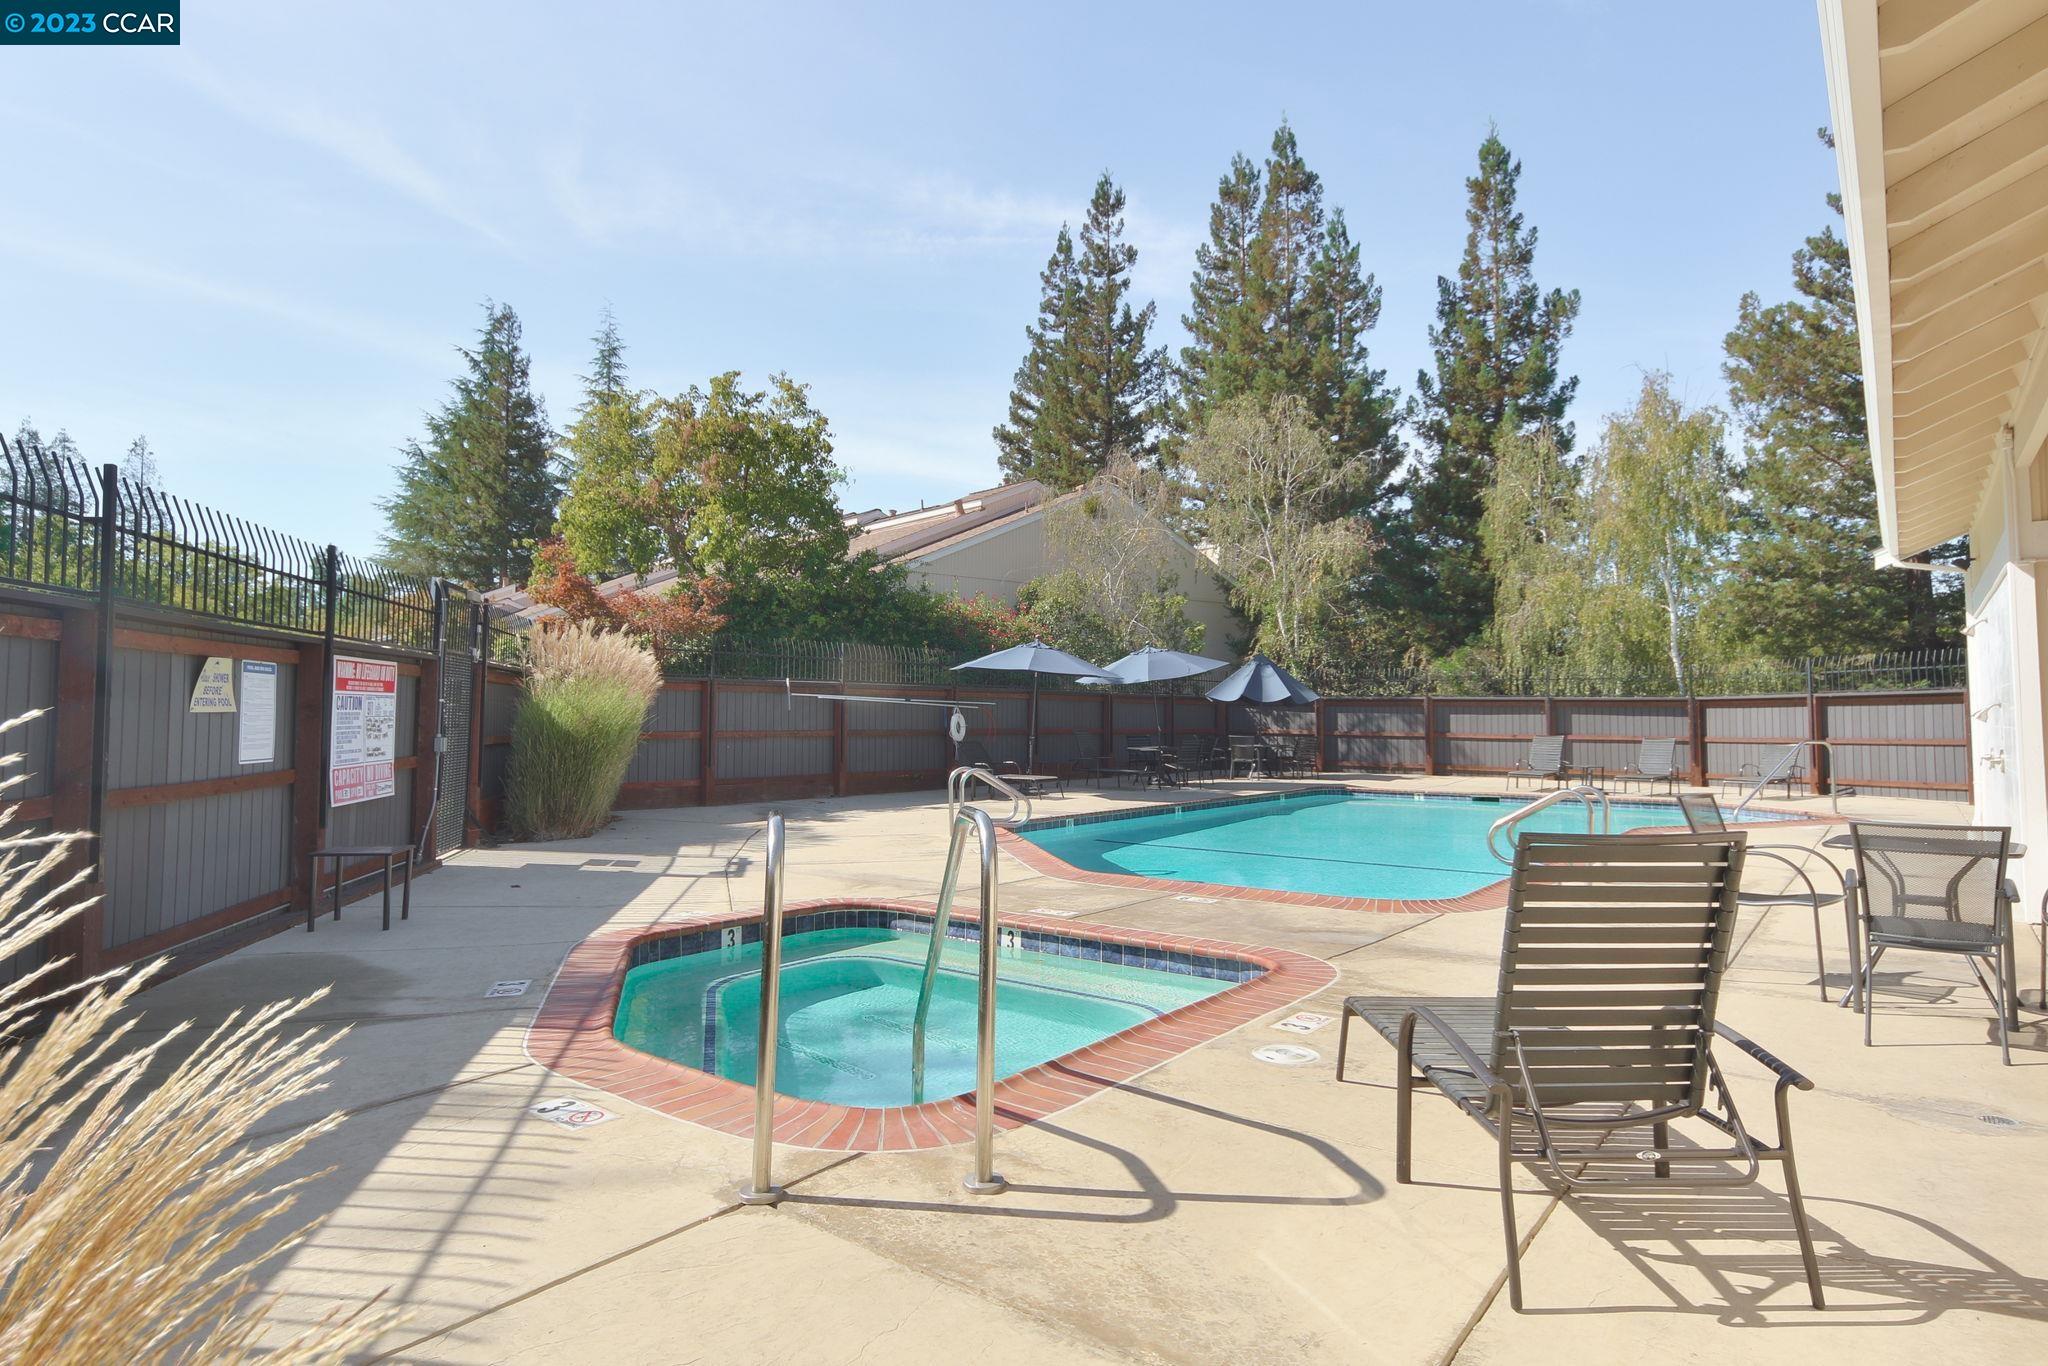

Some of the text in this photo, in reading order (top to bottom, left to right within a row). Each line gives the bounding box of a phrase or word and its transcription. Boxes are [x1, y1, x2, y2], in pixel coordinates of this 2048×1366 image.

[212, 672, 229, 683] SHOWER
[203, 685, 223, 695] BEFORE
[193, 697, 232, 707] ENTERING POOL
[336, 695, 363, 711] CAUTION
[334, 767, 363, 787] CAPACITY
[727, 929, 735, 947] 3
[1007, 930, 1014, 948] 3
[537, 1101, 577, 1114] 3
